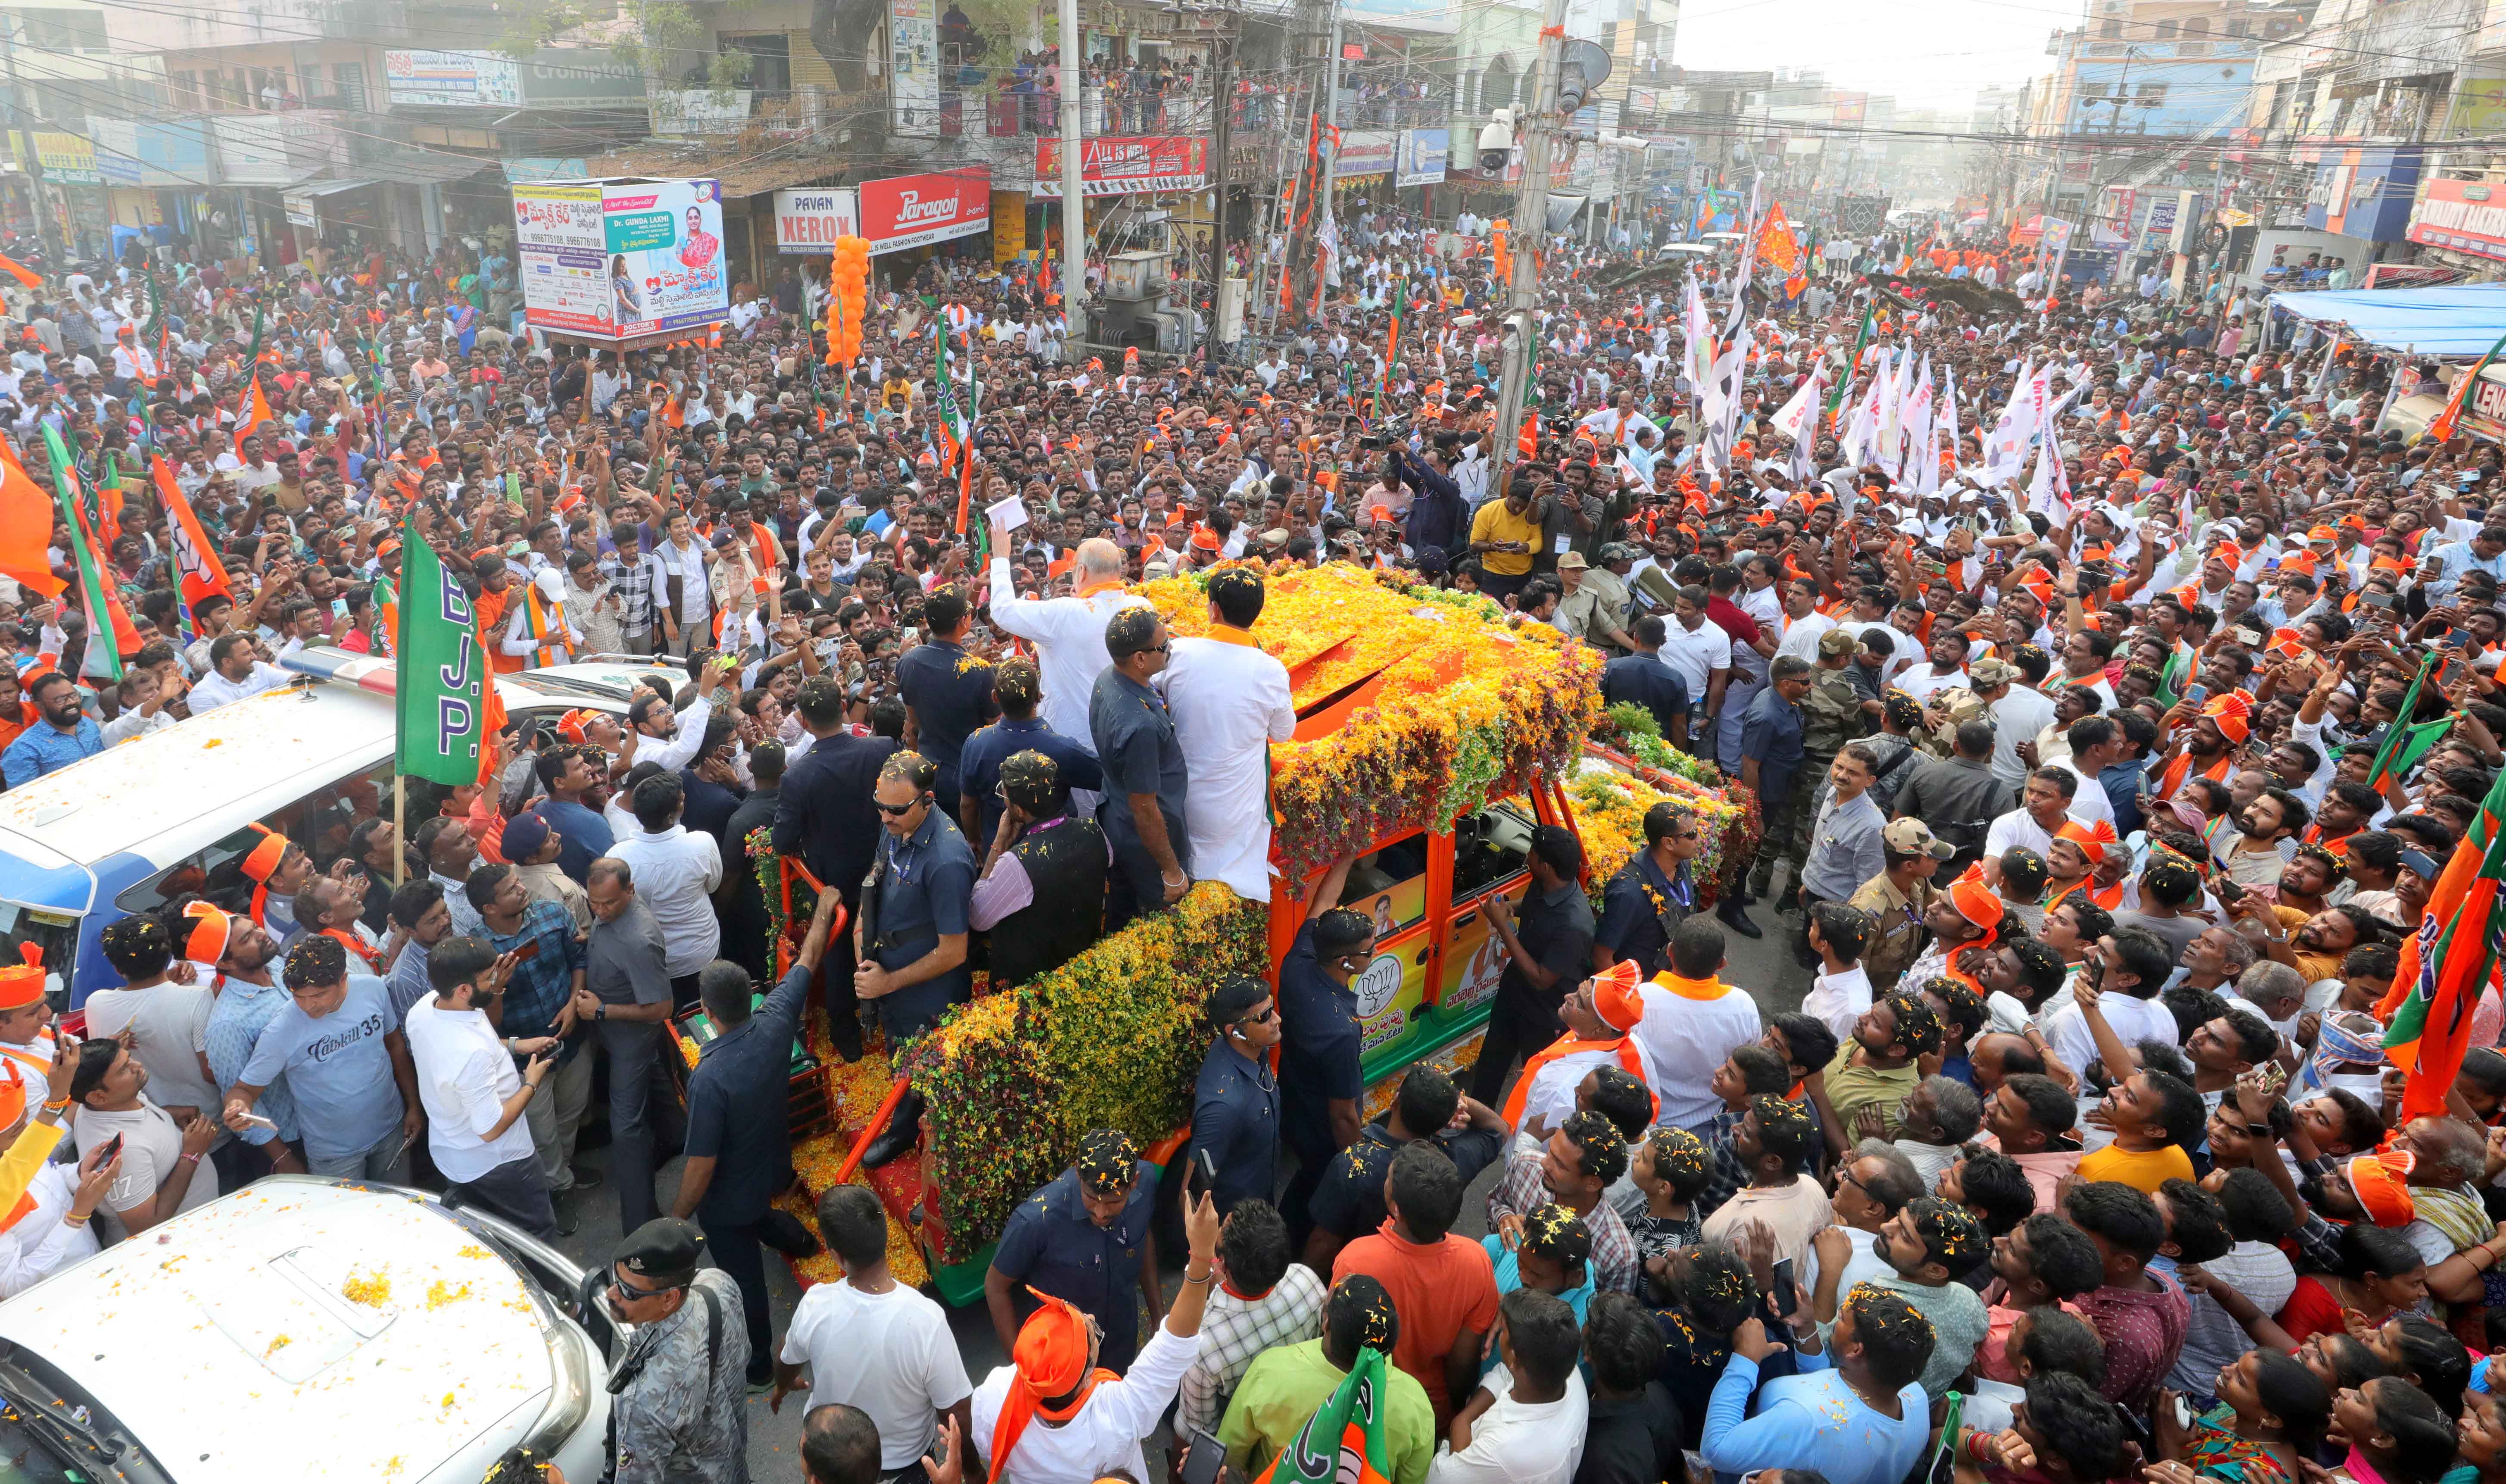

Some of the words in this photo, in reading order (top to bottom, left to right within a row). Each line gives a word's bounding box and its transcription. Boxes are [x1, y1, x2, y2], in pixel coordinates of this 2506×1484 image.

[534, 61, 635, 84] Crompton
[1116, 145, 1125, 161] IS
[1127, 145, 1150, 160] WELL
[795, 197, 833, 212] PAVAN
[896, 190, 958, 221] Paragon
[625, 218, 648, 226] GUNDA
[649, 215, 669, 224] LAXMI
[782, 216, 850, 243] XEROX
[567, 236, 601, 247] 9966776108
[874, 243, 879, 251] IS
[879, 240, 892, 250] WELL
[892, 237, 911, 249] FASHION
[911, 233, 935, 244] FOOTWEAR
[700, 264, 718, 281] కేర్
[622, 326, 657, 336] APPOINTMENT
[623, 321, 655, 330] DOCTOR'S
[624, 340, 641, 349] DRIVE
[684, 329, 708, 339] JOYFULLY
[361, 1013, 381, 1037] 35
